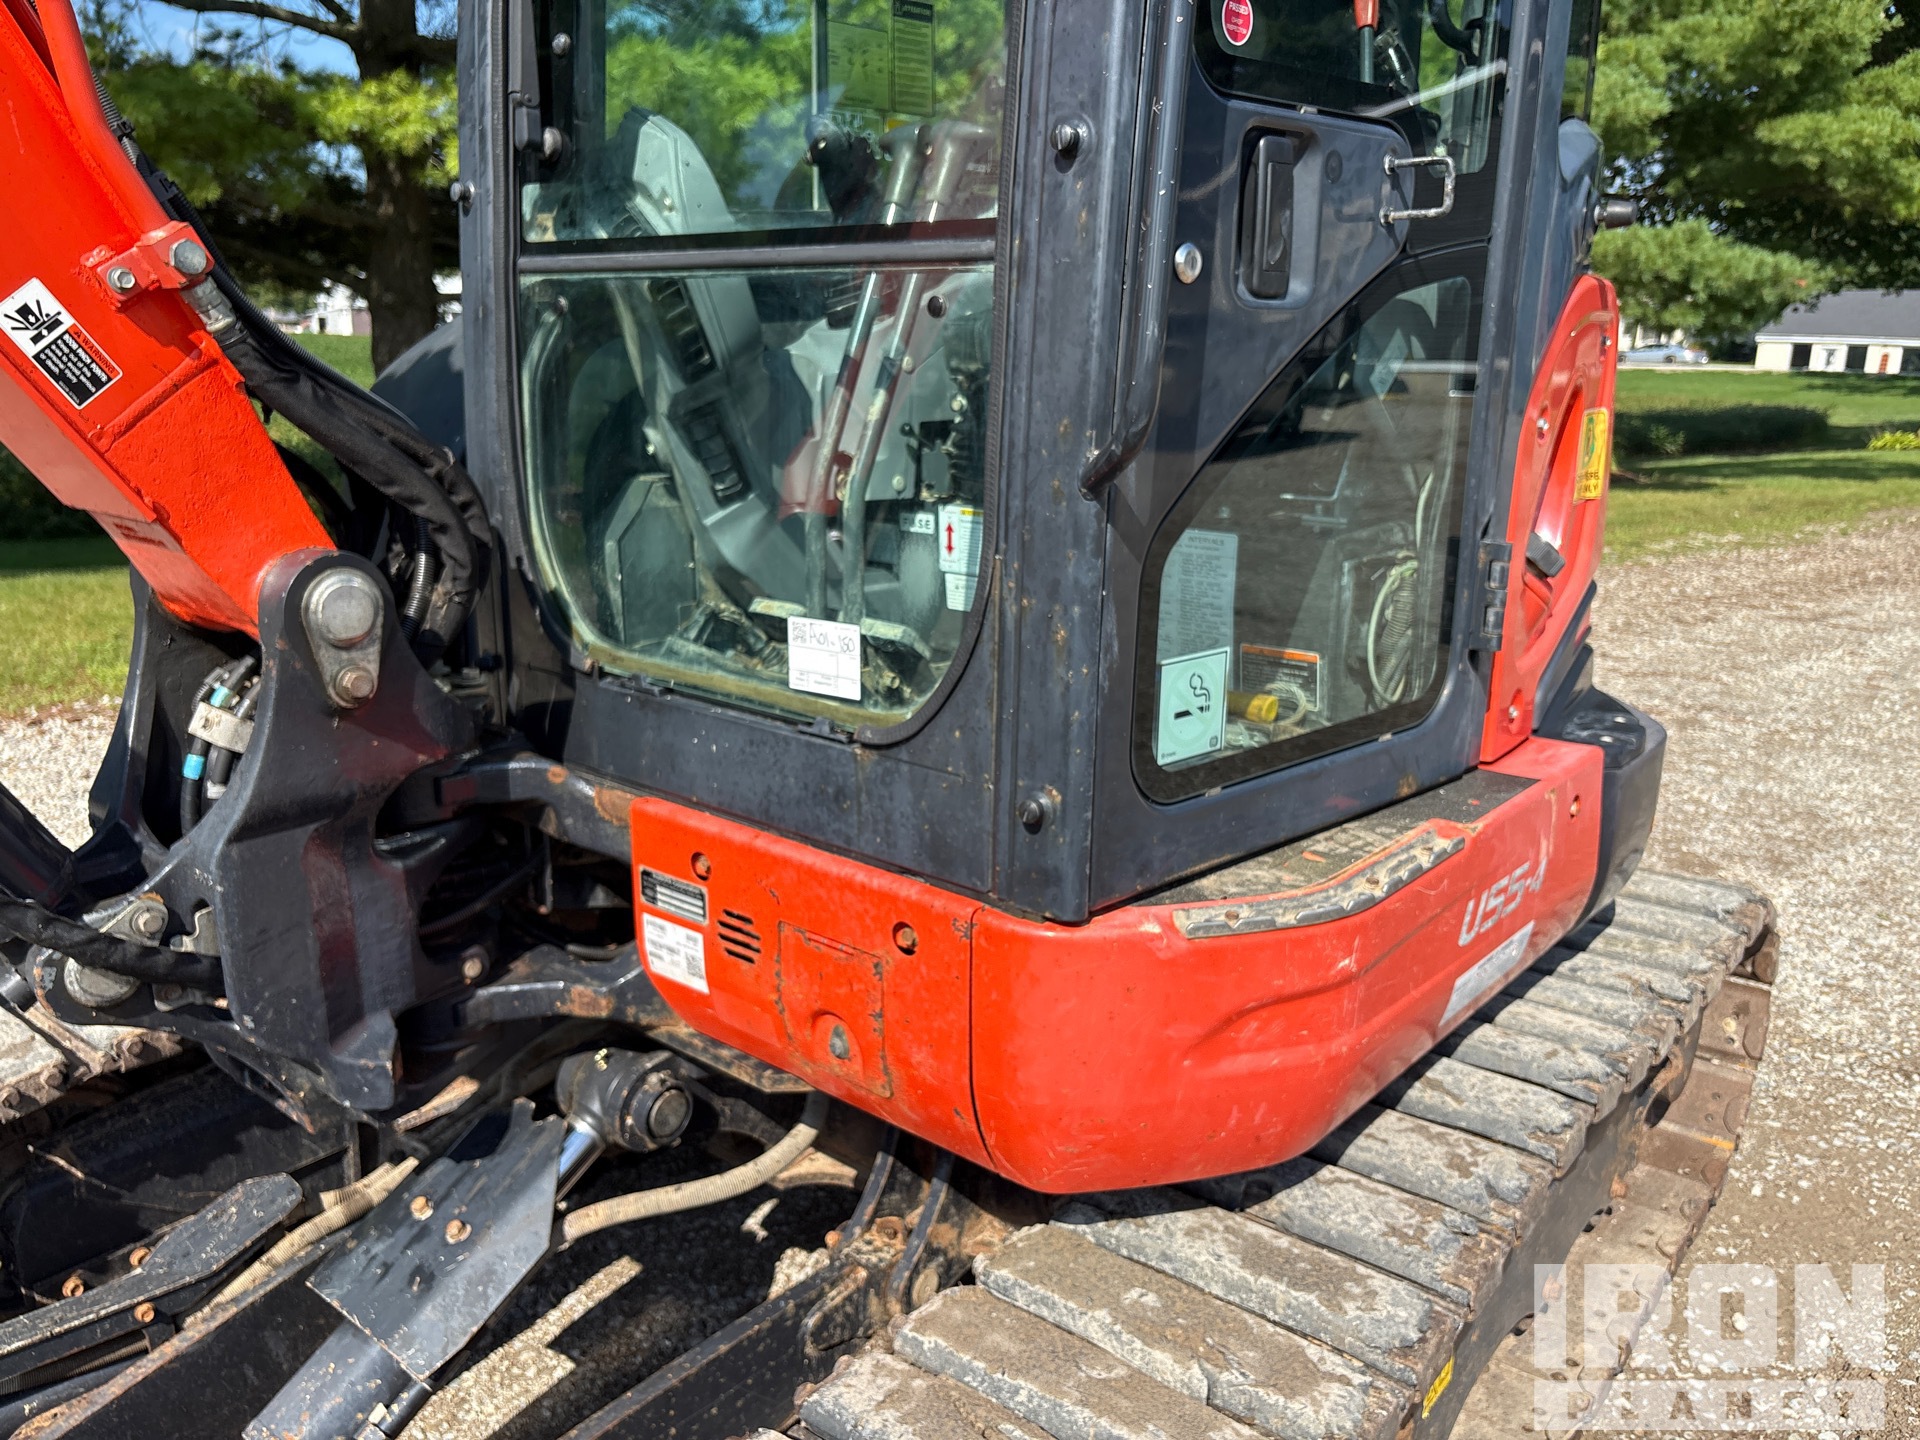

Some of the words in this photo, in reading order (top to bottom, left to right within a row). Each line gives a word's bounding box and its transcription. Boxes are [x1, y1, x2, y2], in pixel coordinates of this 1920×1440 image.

[1229, 1, 1249, 15] PASSED
[45, 348, 66, 370] personal
[64, 368, 78, 383] injury
[57, 339, 69, 354] Keep
[69, 353, 78, 362] out
[77, 360, 83, 369] of
[82, 366, 91, 378] this
[76, 347, 91, 364] PINCH
[82, 338, 115, 373] WARNING
[61, 355, 68, 363] to
[67, 361, 81, 376] avoid
[79, 375, 96, 393] serious
